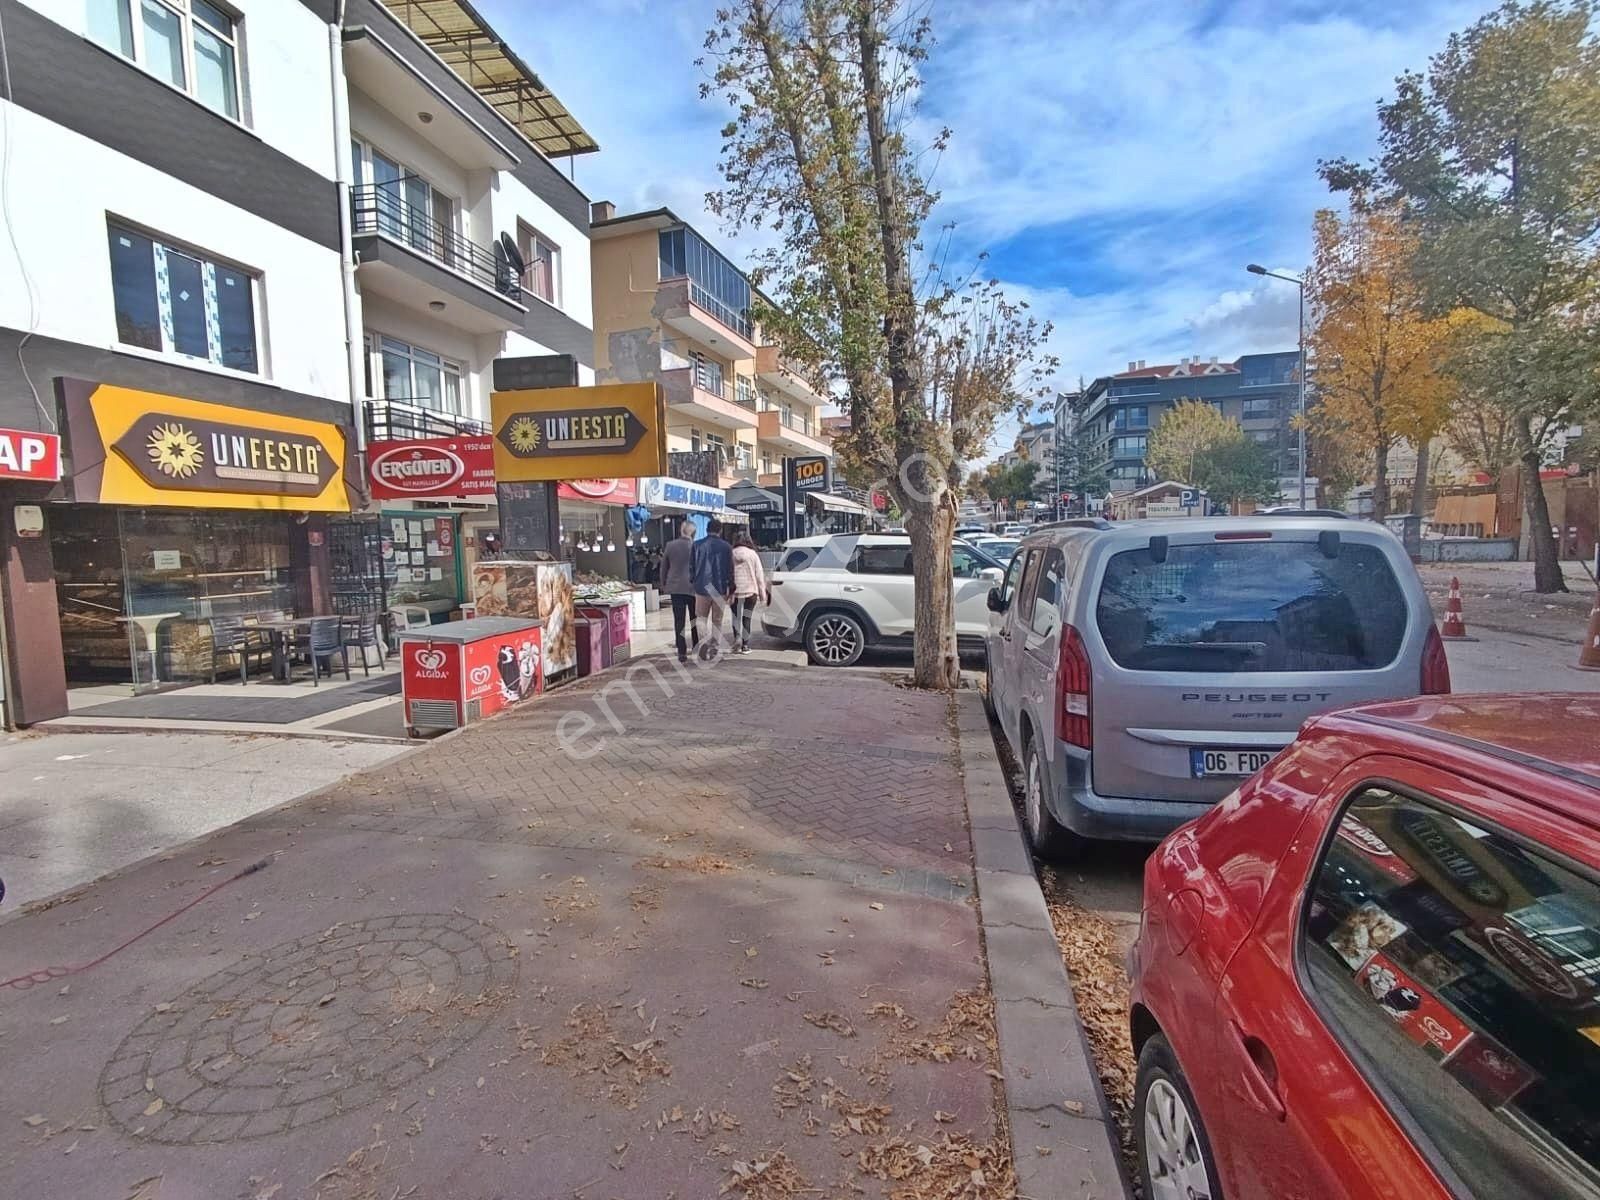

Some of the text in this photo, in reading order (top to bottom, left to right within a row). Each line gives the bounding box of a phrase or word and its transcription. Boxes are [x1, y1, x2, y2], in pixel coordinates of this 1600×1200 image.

[546, 415, 625, 440] UNFESTA
[211, 432, 318, 474] UNFESTA
[796, 462, 824, 480] 100
[796, 475, 824, 487] BURGER
[1182, 491, 1192, 506] P
[1182, 693, 1332, 702] PEUGEOT
[1206, 753, 1227, 771] 06
